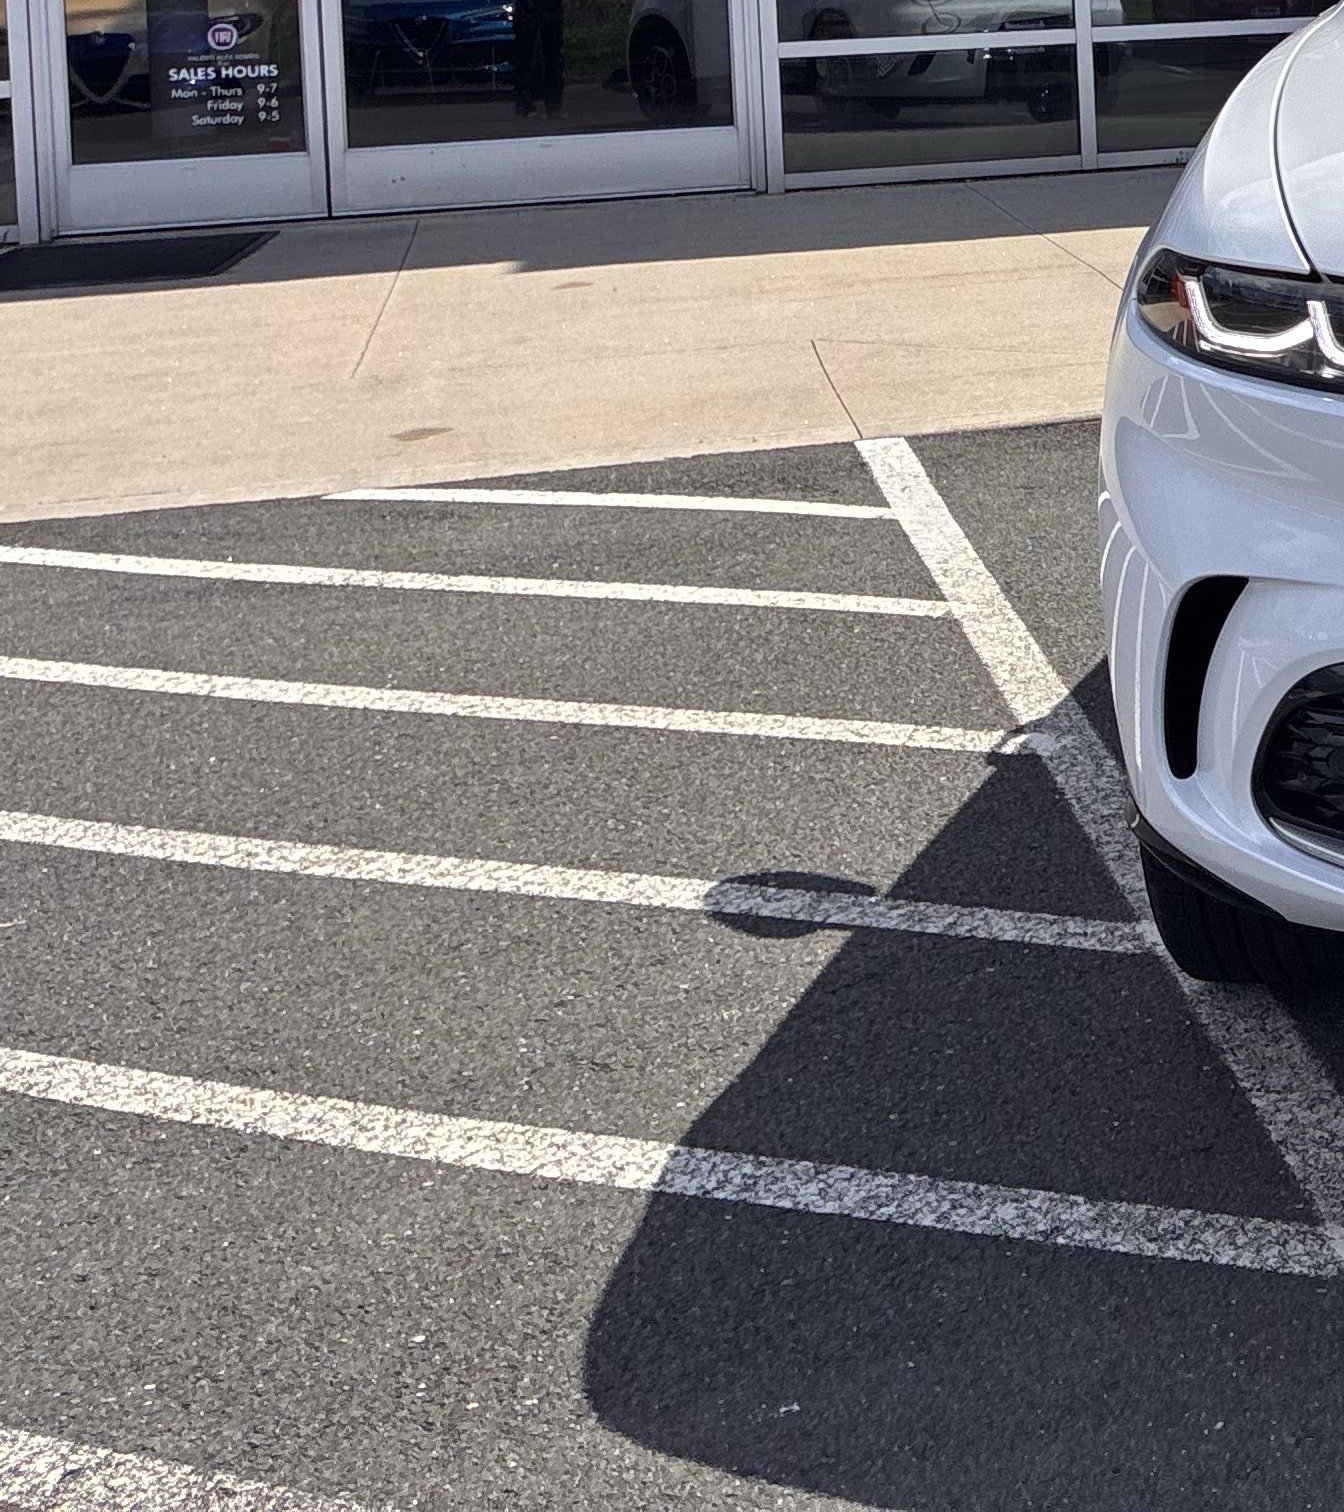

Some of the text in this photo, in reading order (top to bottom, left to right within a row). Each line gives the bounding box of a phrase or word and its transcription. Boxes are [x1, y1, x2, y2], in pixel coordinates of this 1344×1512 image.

[168, 64, 279, 81] SALES HOURS
[171, 88, 199, 99] Mon
[209, 86, 243, 97] Thurs
[207, 99, 244, 111] Friday
[191, 112, 245, 126] Saturday
